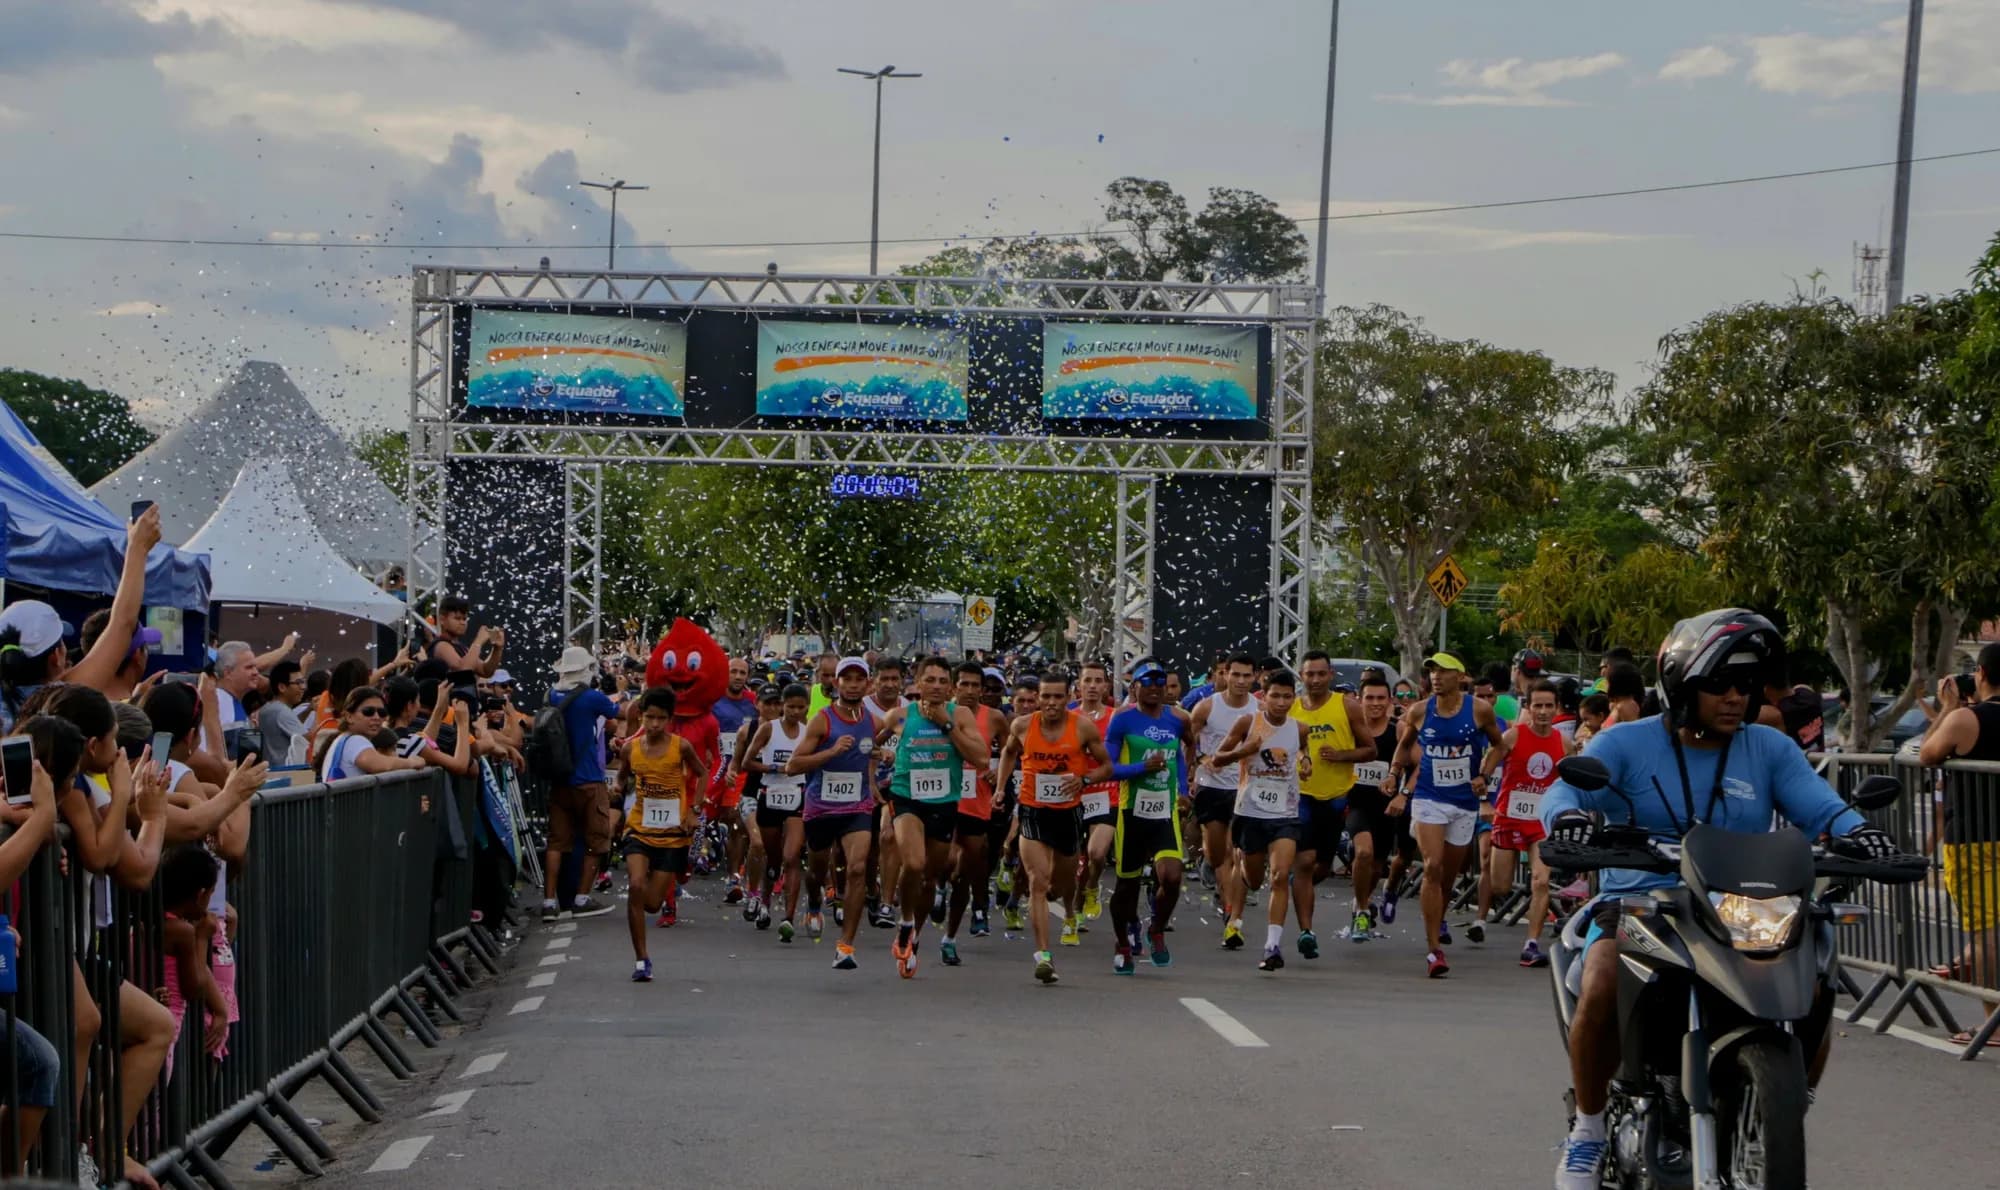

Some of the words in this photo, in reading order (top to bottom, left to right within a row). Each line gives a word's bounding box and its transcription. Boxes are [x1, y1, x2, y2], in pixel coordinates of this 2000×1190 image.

[489, 330, 523, 344] NOSSA
[525, 330, 570, 343] ENERGIA
[572, 332, 604, 345] MOVE
[776, 341, 809, 354] NOSSA
[811, 340, 857, 353] ENERGIA
[859, 340, 888, 352] MOVE
[1062, 342, 1095, 356] NOSSA
[1097, 341, 1142, 353] ENERGIA
[1144, 341, 1173, 352] MOVE
[556, 383, 620, 399] Equador
[844, 391, 907, 406] Equador
[1130, 391, 1193, 407] Equador
[1425, 744, 1473, 758] CAIXA
[1358, 767, 1382, 780] 1194
[1437, 768, 1464, 781] 1413
[826, 782, 854, 796] 1402
[916, 779, 943, 793] 1013
[771, 793, 796, 805] 1217
[1258, 790, 1278, 804] 449
[1139, 800, 1166, 813] 1268
[1515, 802, 1535, 815] 401
[651, 809, 671, 822] 117
